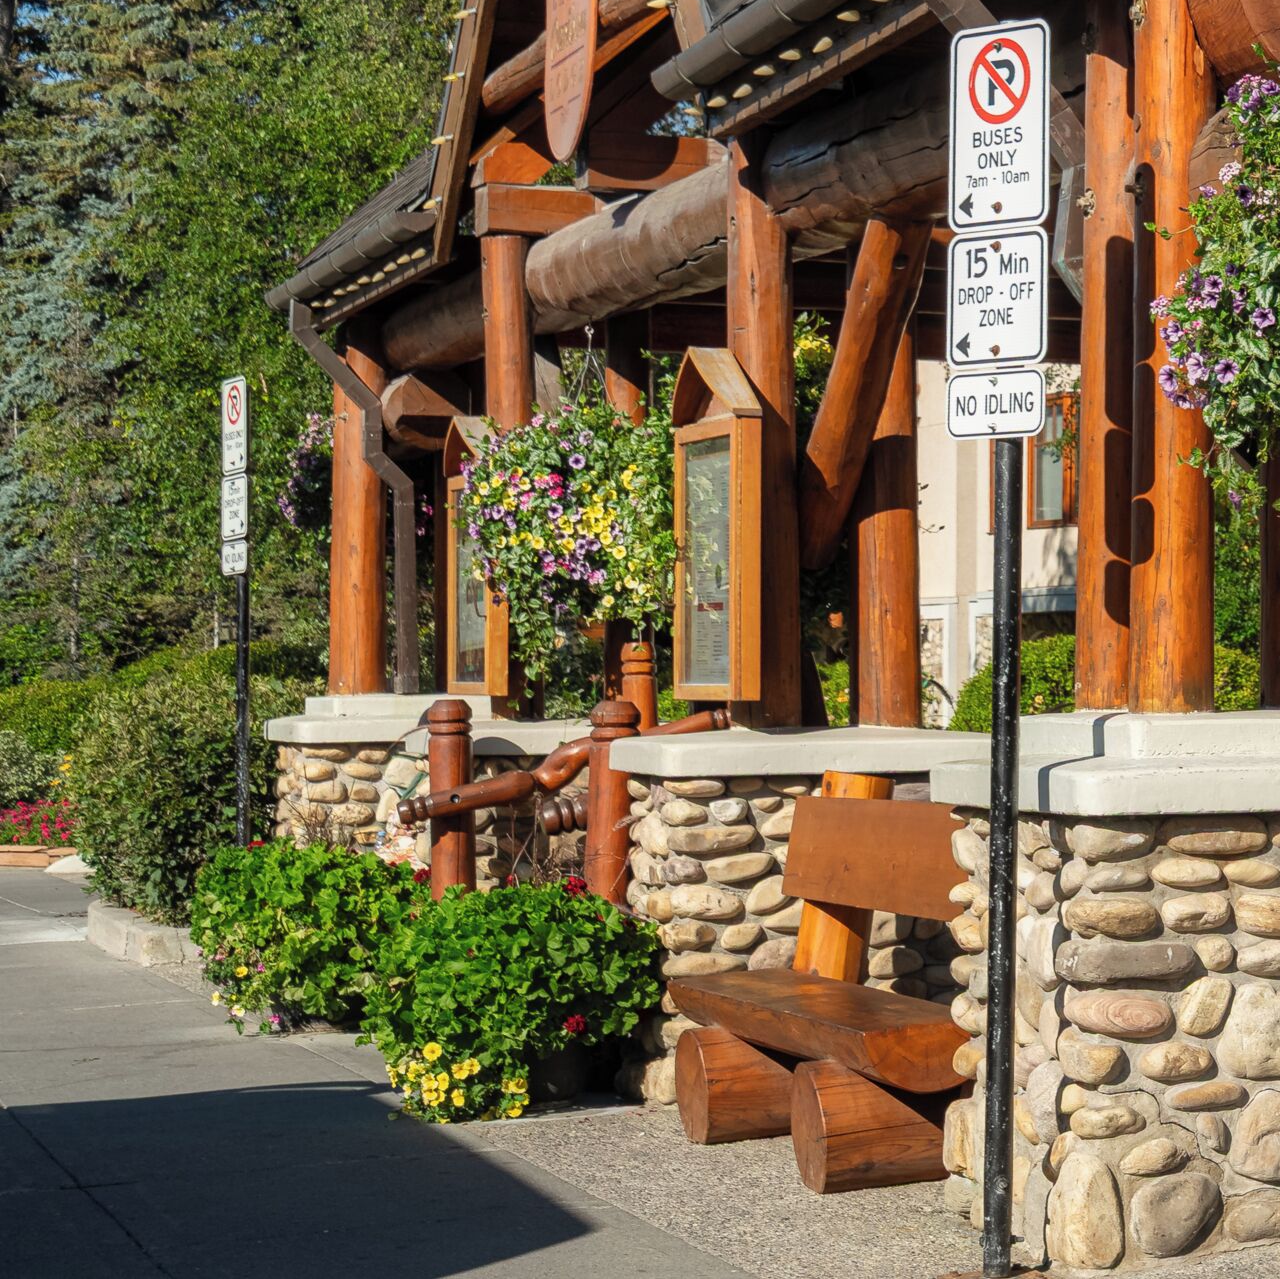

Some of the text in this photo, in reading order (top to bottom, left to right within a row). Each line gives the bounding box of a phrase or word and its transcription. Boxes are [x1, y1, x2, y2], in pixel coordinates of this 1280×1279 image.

[972, 126, 1023, 148] BUSES
[977, 148, 1017, 169] ONLY
[965, 175, 988, 188] 7am
[1002, 170, 1029, 184] 10am
[965, 247, 1029, 279] 15 Min
[958, 285, 993, 306] DROP
[1009, 281, 1035, 301] OFF
[979, 307, 1014, 327] ZONE
[956, 391, 1034, 416] NO IDLING
